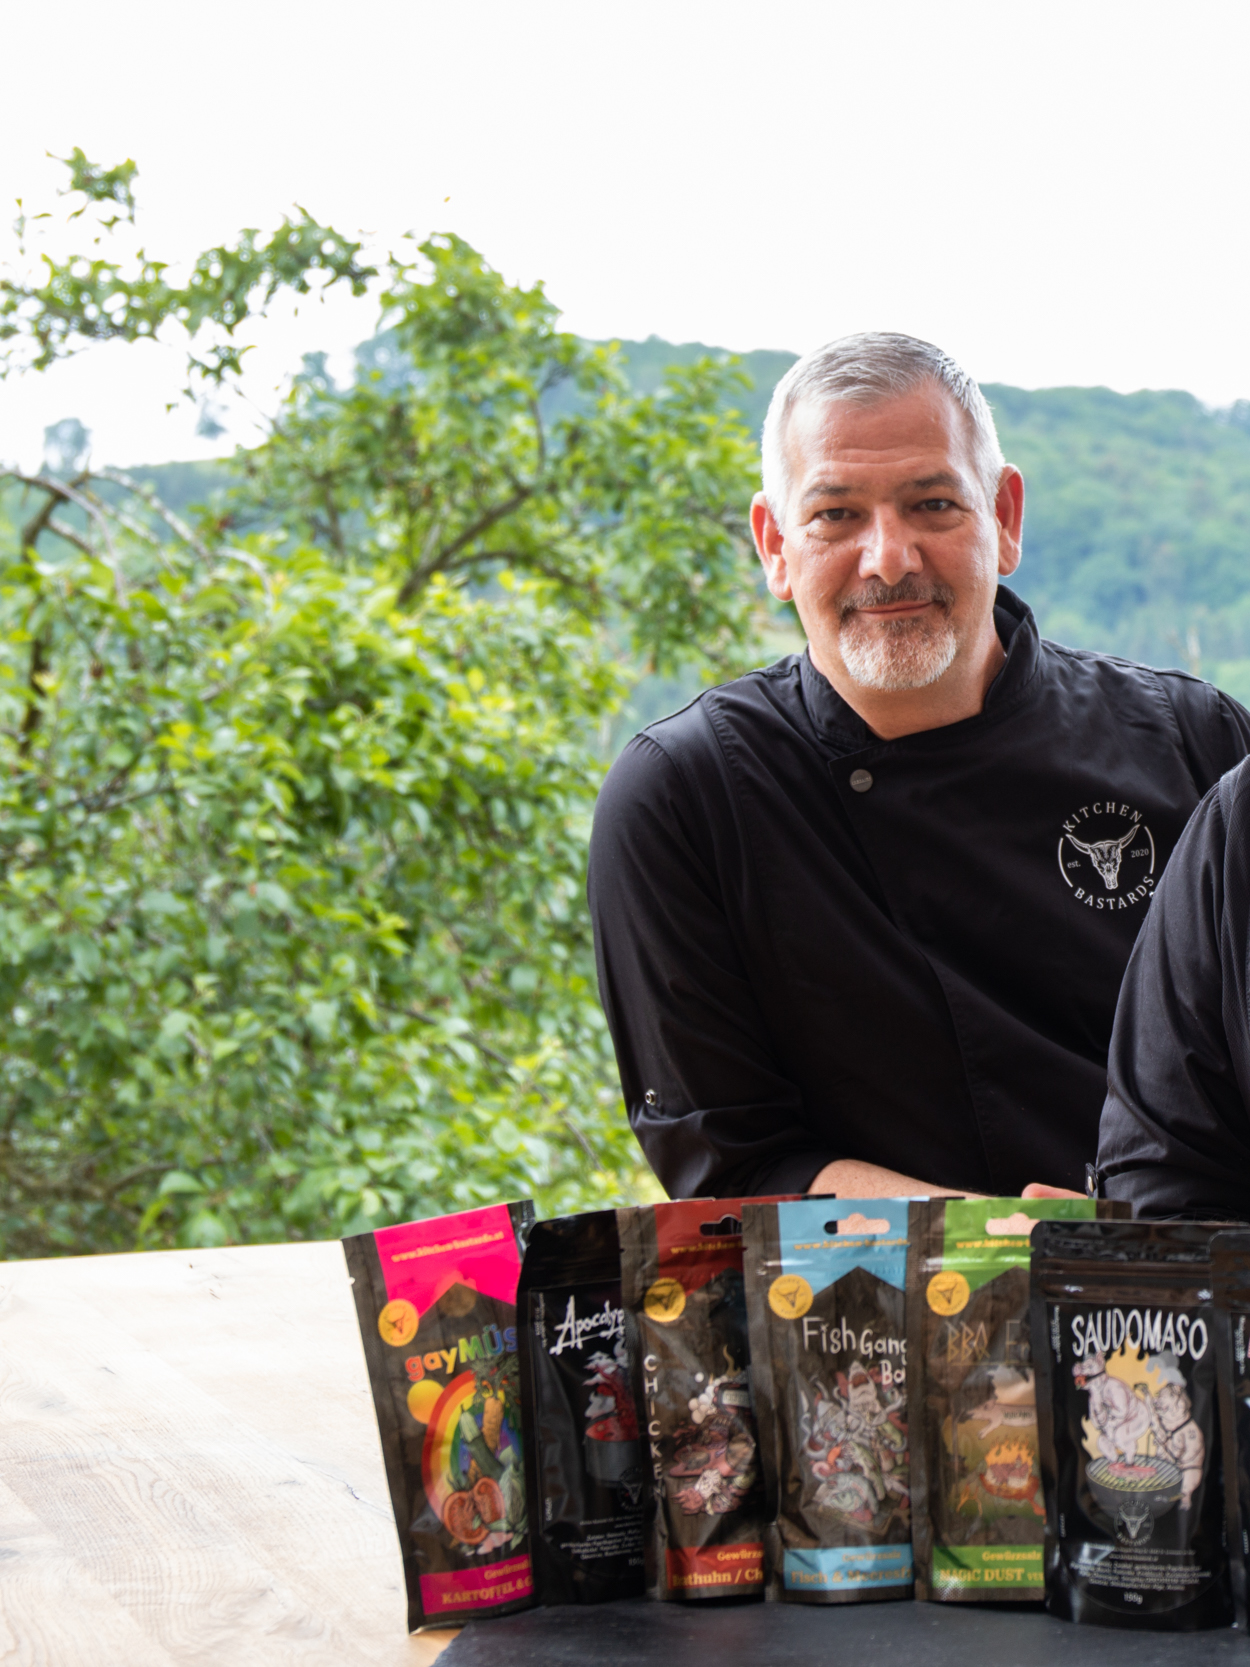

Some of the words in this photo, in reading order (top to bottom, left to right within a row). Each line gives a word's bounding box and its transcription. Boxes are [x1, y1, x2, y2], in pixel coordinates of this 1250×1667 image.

[1063, 802, 1142, 833] KITCHEN
[1067, 860, 1081, 869] est.
[1131, 848, 1149, 858] 2020
[1074, 876, 1154, 910] BASTARDS
[803, 1316, 857, 1354] Fish
[945, 1320, 990, 1364] BBQ
[1071, 1307, 1208, 1361] SAUDOMASO
[644, 1354, 666, 1499] CHICKEN
[791, 1570, 828, 1584] Fisch
[832, 1570, 843, 1583] &
[941, 1568, 981, 1582] MAGIC
[983, 1567, 1025, 1582] DUST
